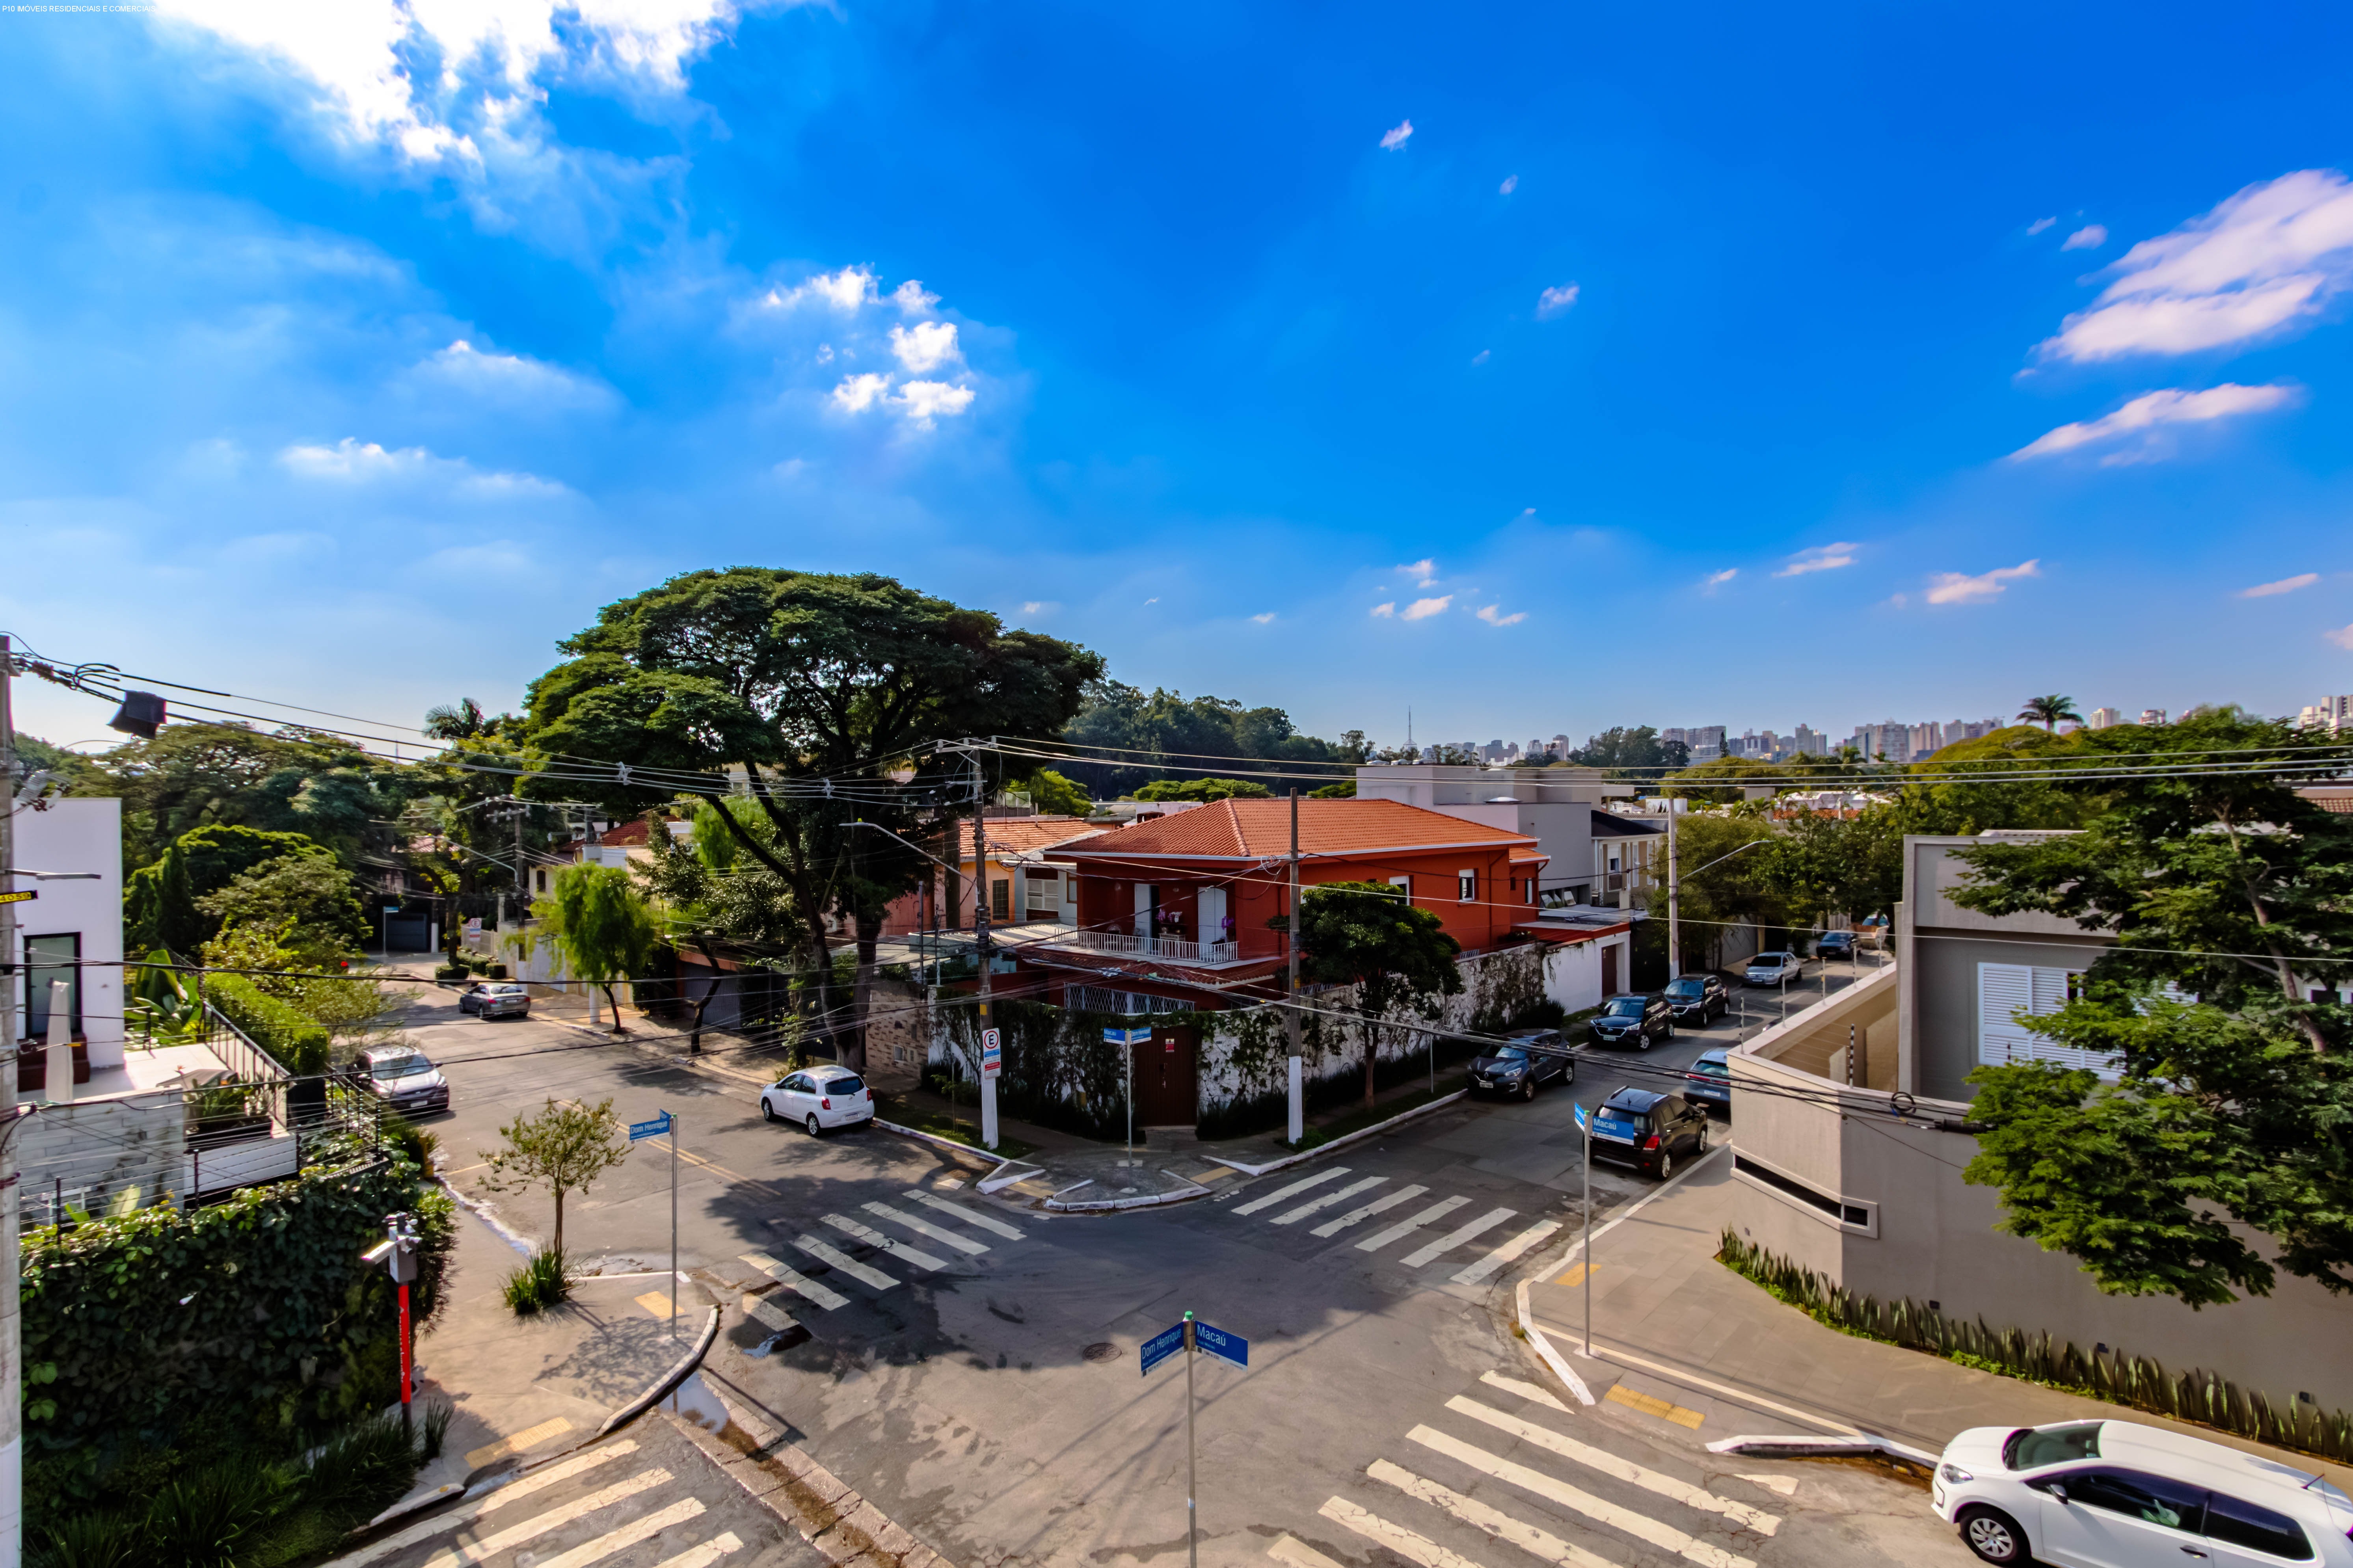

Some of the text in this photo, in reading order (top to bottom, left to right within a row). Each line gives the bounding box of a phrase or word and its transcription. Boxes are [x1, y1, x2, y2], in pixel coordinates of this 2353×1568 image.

[988, 1034, 994, 1045] E
[630, 1121, 668, 1134] Dom Henrique
[1593, 1118, 1617, 1130] Macaú
[1197, 1324, 1226, 1347] Macaú
[1141, 1343, 1156, 1360] Dom
[1157, 1328, 1182, 1350] Henrique
